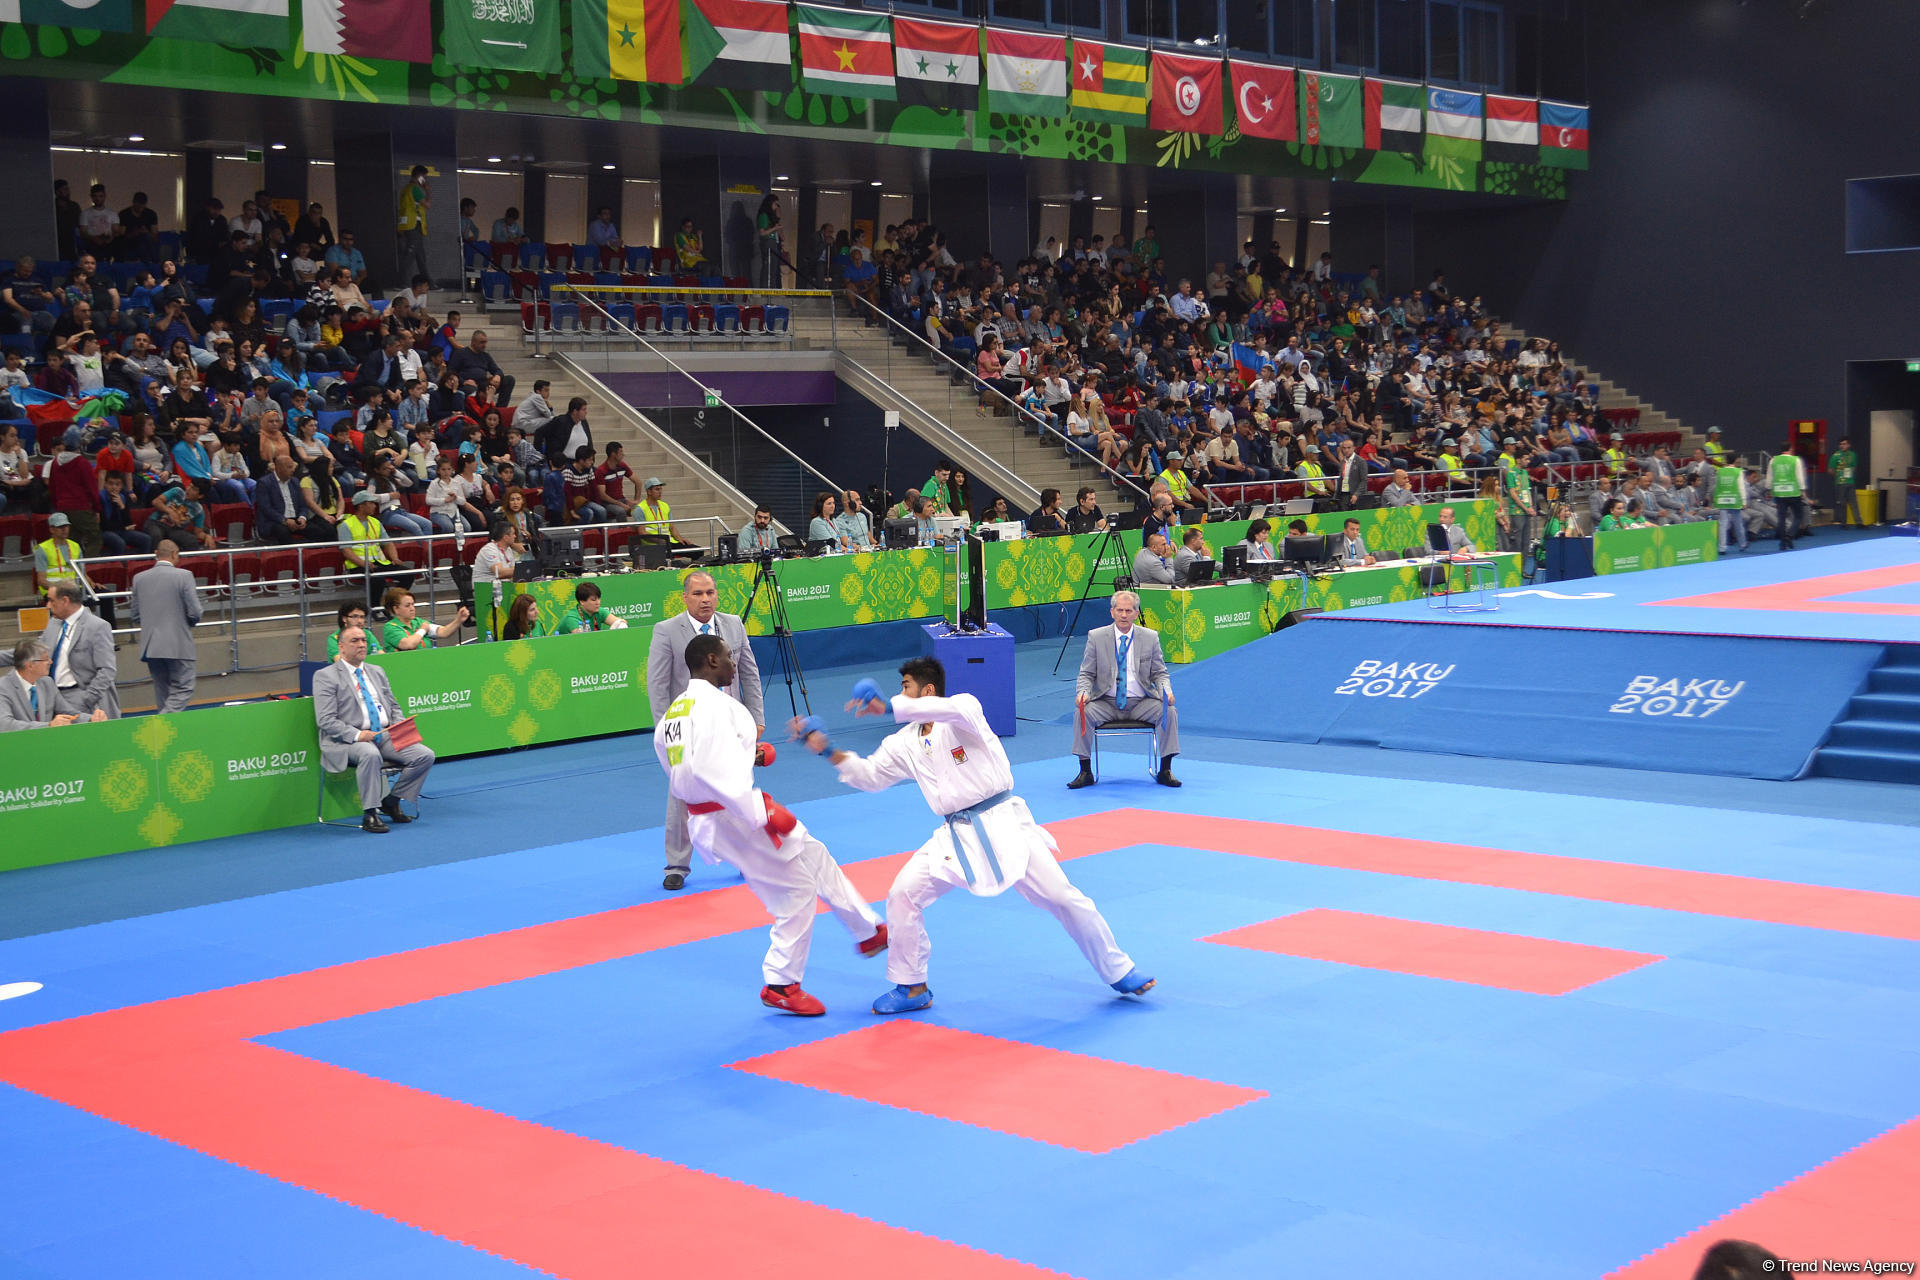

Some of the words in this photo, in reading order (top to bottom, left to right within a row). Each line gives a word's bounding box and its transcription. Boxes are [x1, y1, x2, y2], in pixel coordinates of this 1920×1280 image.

[1111, 556, 1127, 564] 207
[787, 587, 809, 597] BAKU
[810, 584, 830, 595] 2017
[629, 602, 652, 614] 2017
[1214, 614, 1232, 624] BAKU
[1233, 611, 1251, 622] 2017
[571, 674, 599, 687] BAKU
[601, 670, 628, 684] 2017
[1350, 659, 1456, 681] BAKU
[1334, 677, 1439, 699] 2017
[1624, 675, 1746, 699] BAKU
[408, 693, 439, 708] BAKU
[442, 689, 471, 703] 2017
[1608, 694, 1730, 718] 2017
[227, 755, 266, 773] BAKU
[270, 750, 307, 767] 2017
[260, 768, 288, 776] Solidarity
[288, 765, 308, 773] Games
[42, 780, 84, 798] 2017
[30, 798, 62, 808] Solidarity
